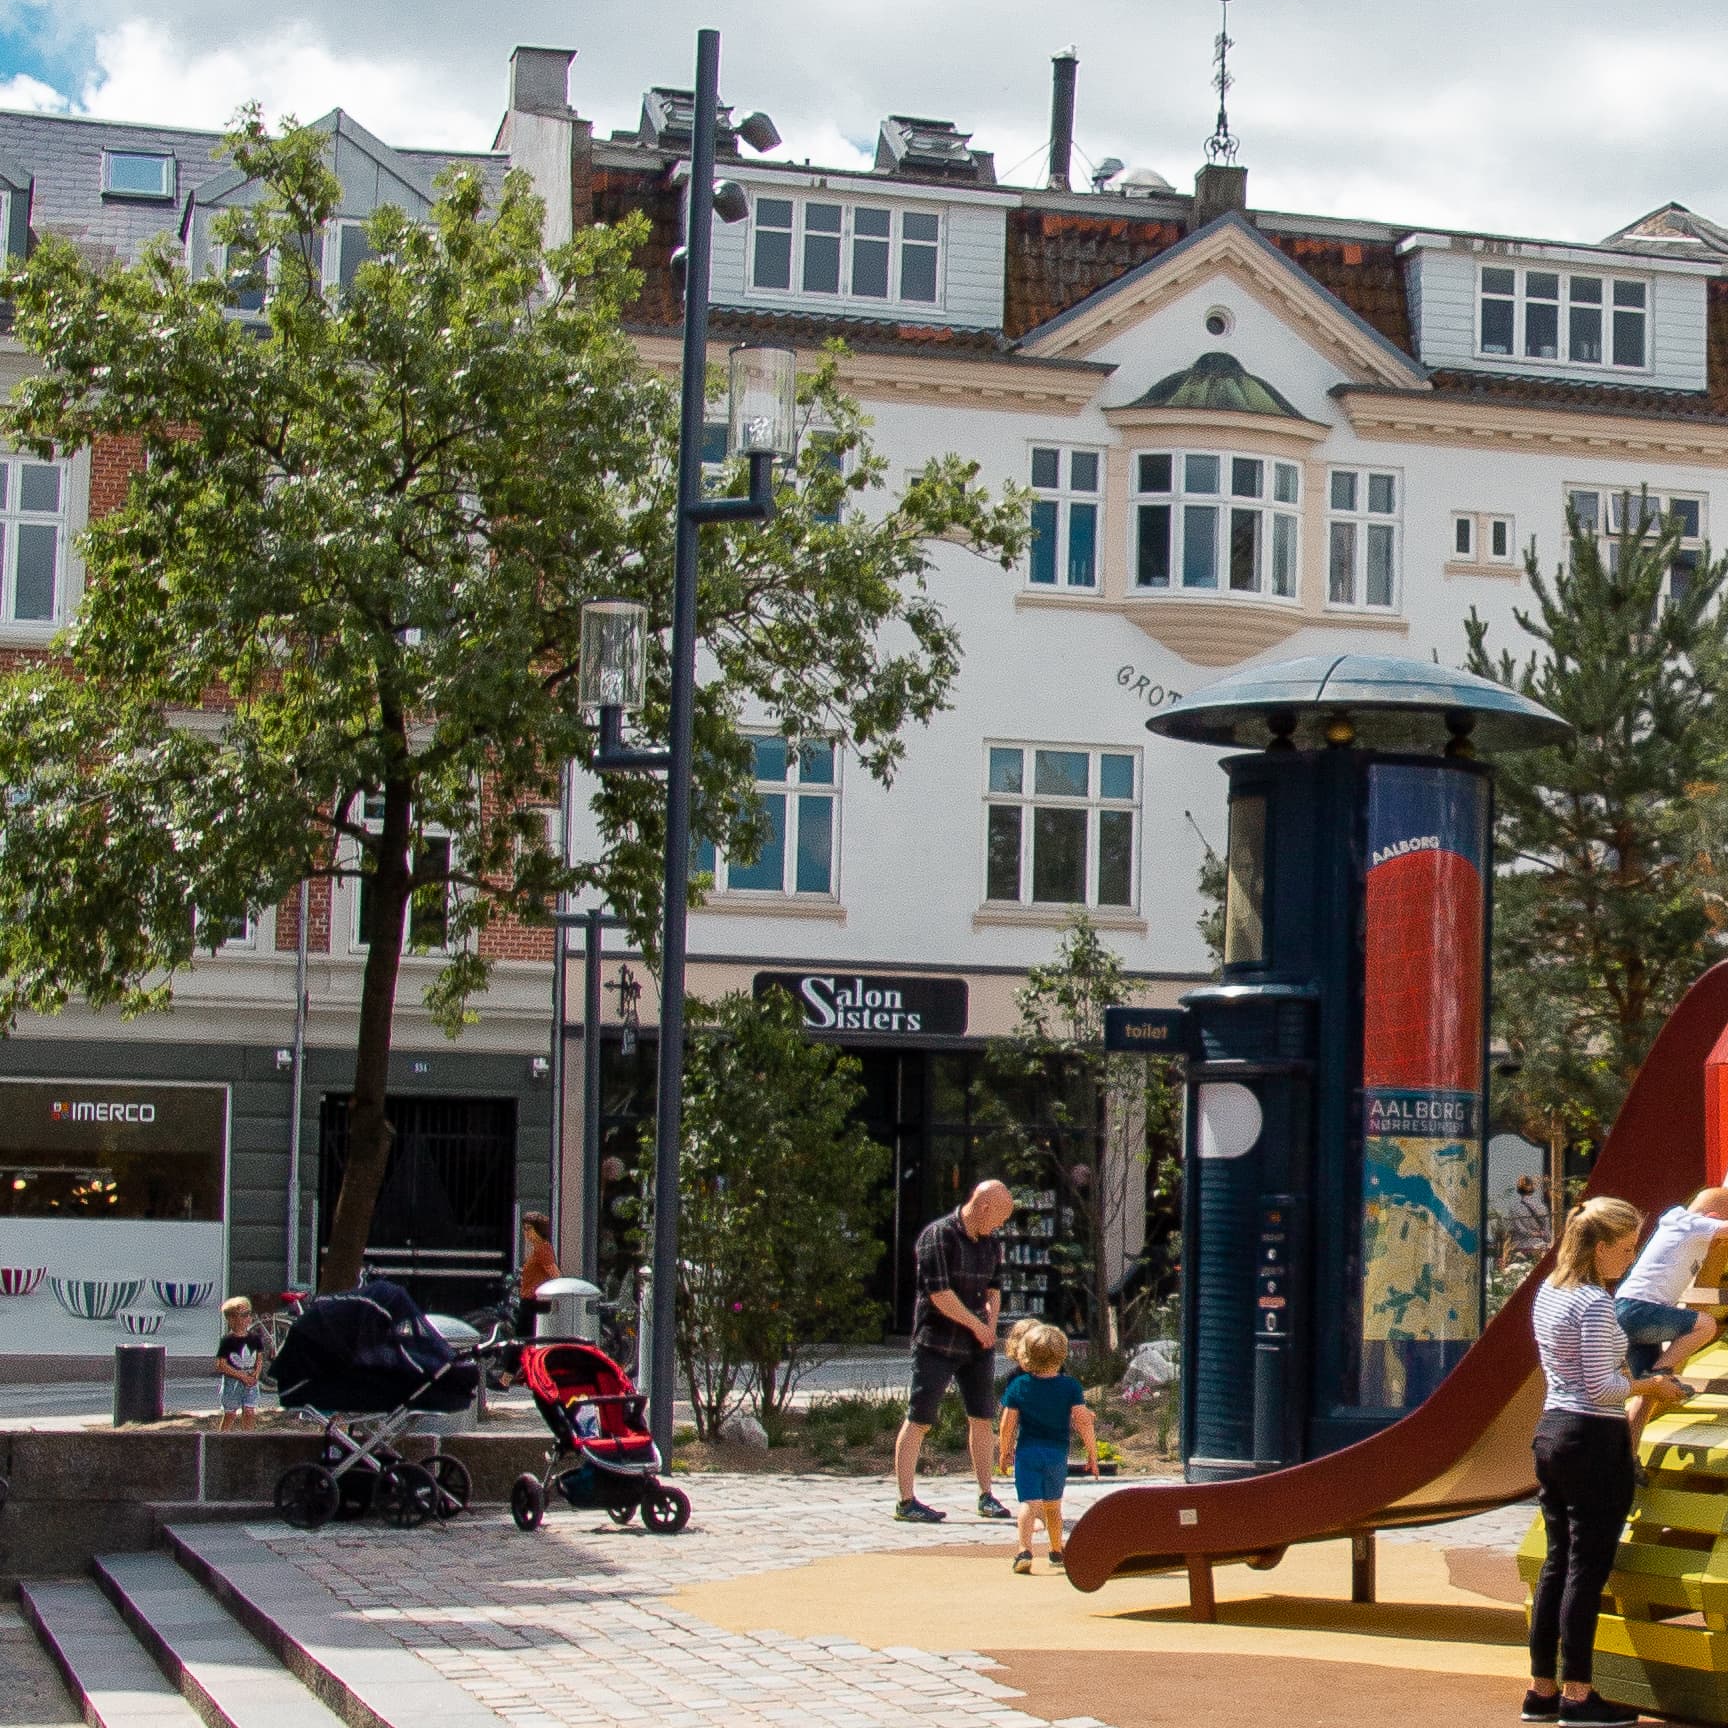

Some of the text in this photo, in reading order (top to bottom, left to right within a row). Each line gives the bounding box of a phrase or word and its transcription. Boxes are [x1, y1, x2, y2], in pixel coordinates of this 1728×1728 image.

[1372, 836, 1440, 865] AALBORG
[802, 977, 902, 1028] Salon
[1124, 1023, 1168, 1040] toilet
[72, 1101, 155, 1123] IMERCO
[1371, 1099, 1465, 1121] AALBORG
